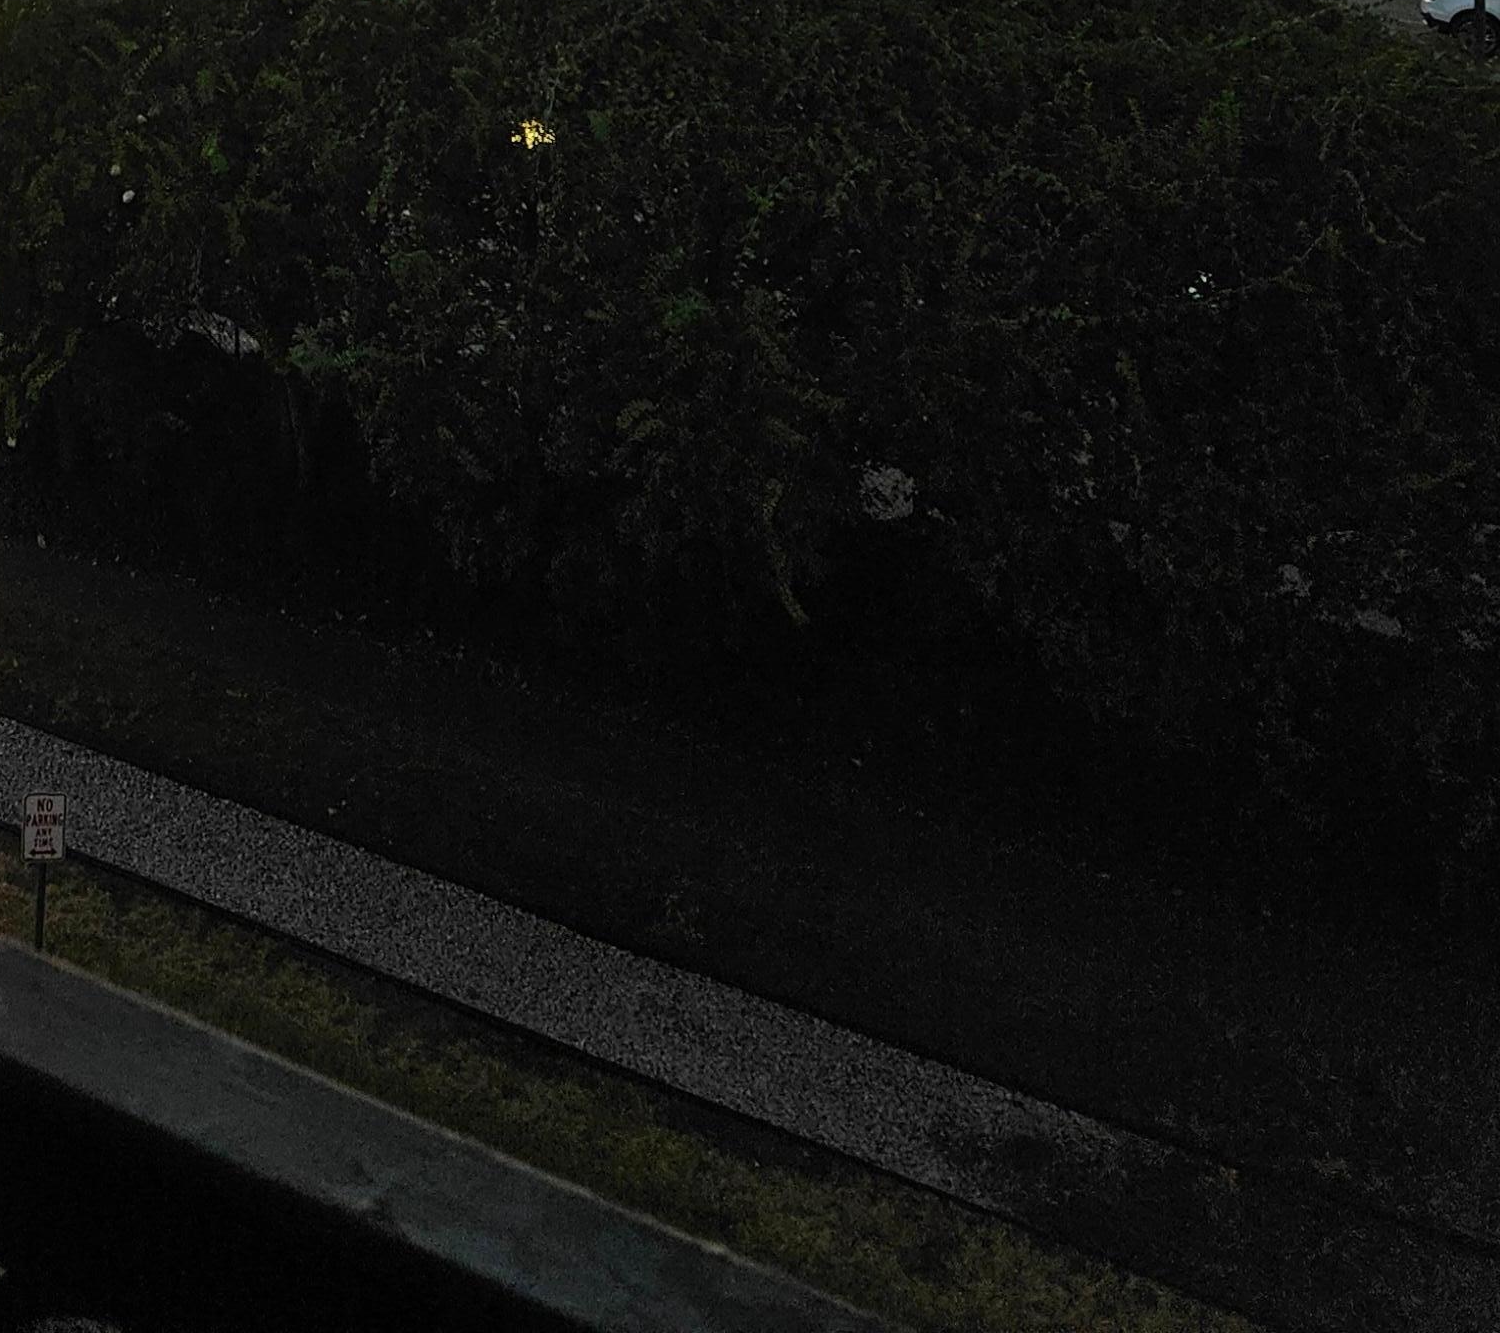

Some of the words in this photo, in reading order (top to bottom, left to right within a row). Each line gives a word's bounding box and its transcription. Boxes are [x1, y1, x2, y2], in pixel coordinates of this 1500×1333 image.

[37, 798, 53, 812] NO
[26, 814, 64, 827] PARKING
[36, 828, 52, 836] ANY
[34, 837, 53, 847] TIME
